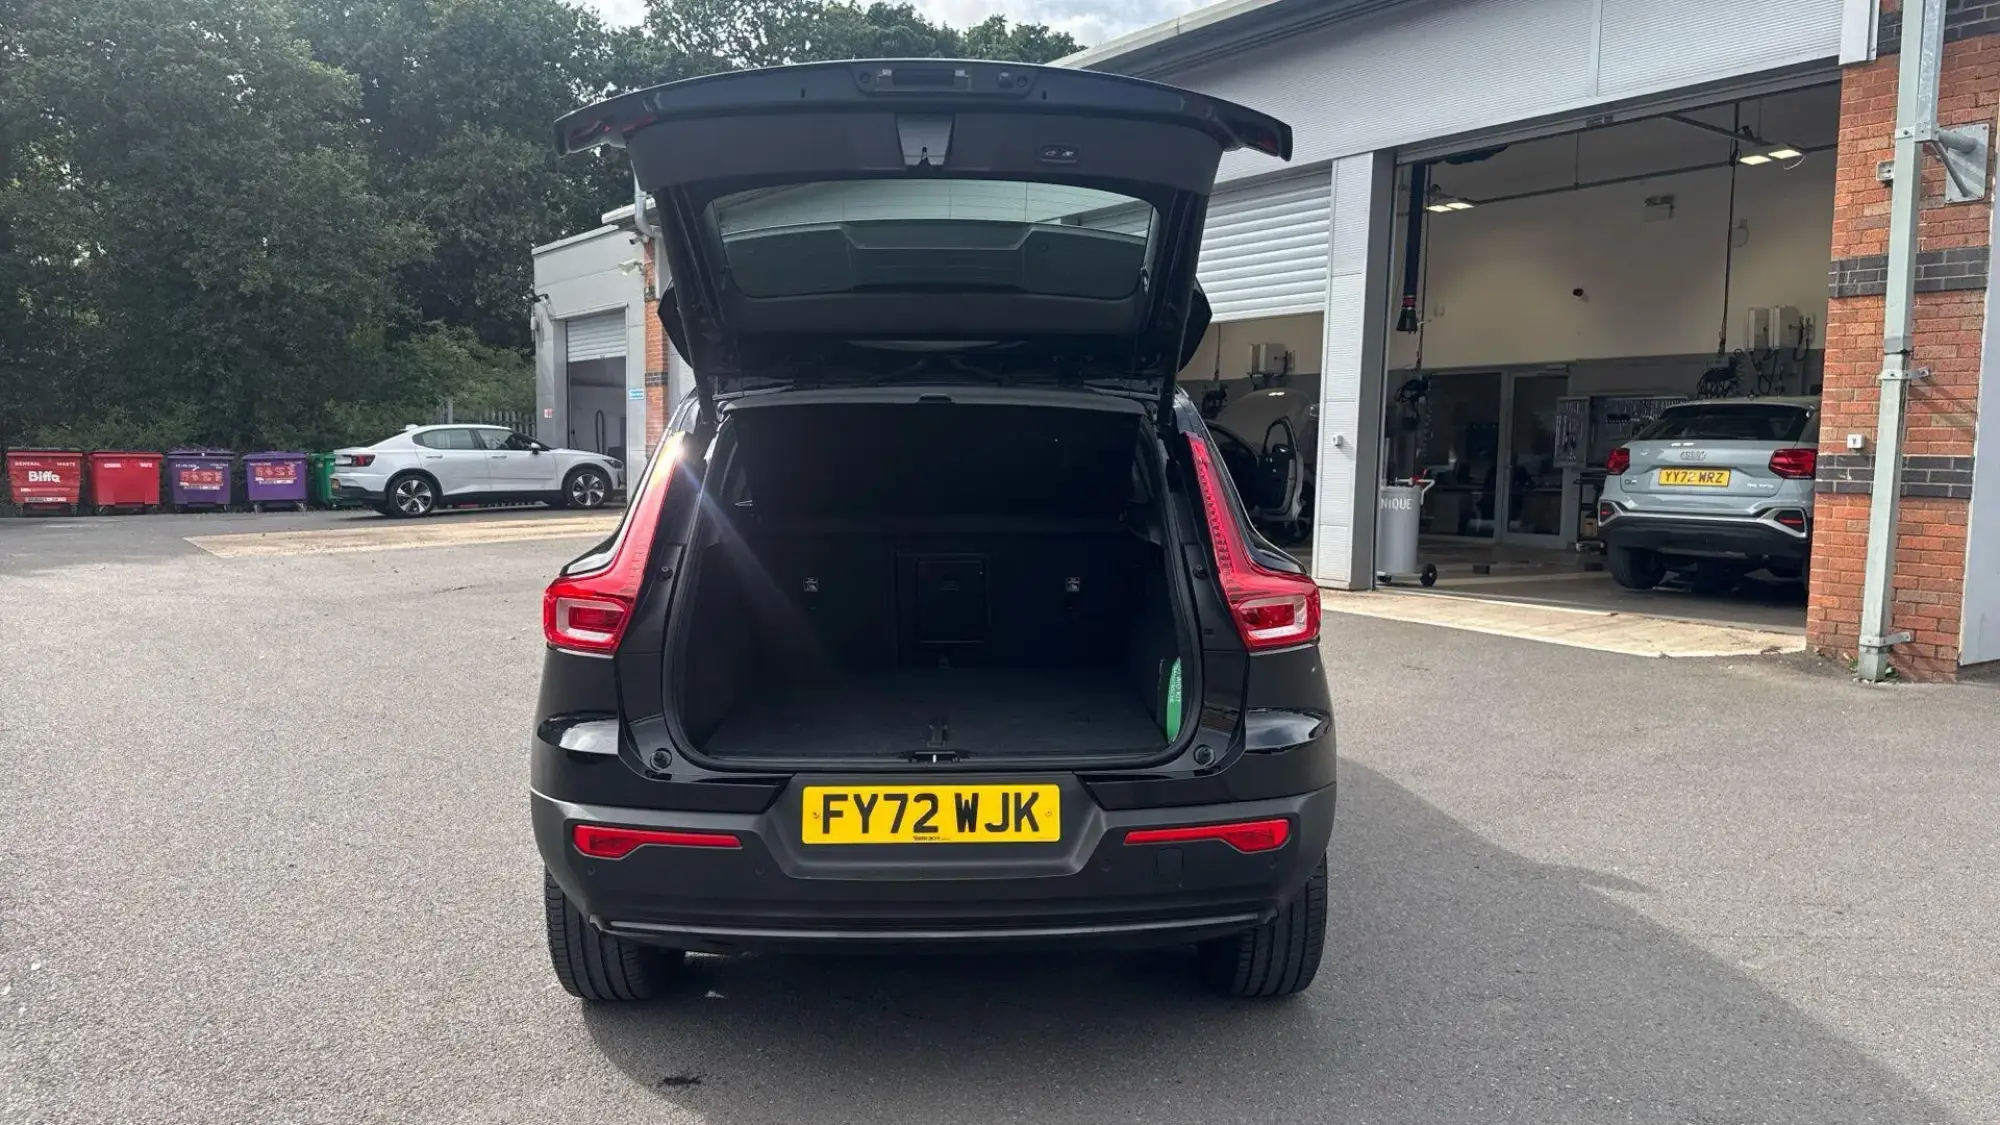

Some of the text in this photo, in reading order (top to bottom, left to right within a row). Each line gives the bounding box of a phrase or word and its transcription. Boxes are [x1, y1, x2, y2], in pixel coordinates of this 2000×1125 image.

[28, 470, 61, 483] Biffa
[1665, 472, 1724, 484] YY72 WRZ
[822, 792, 1040, 834] FY72 WJK
